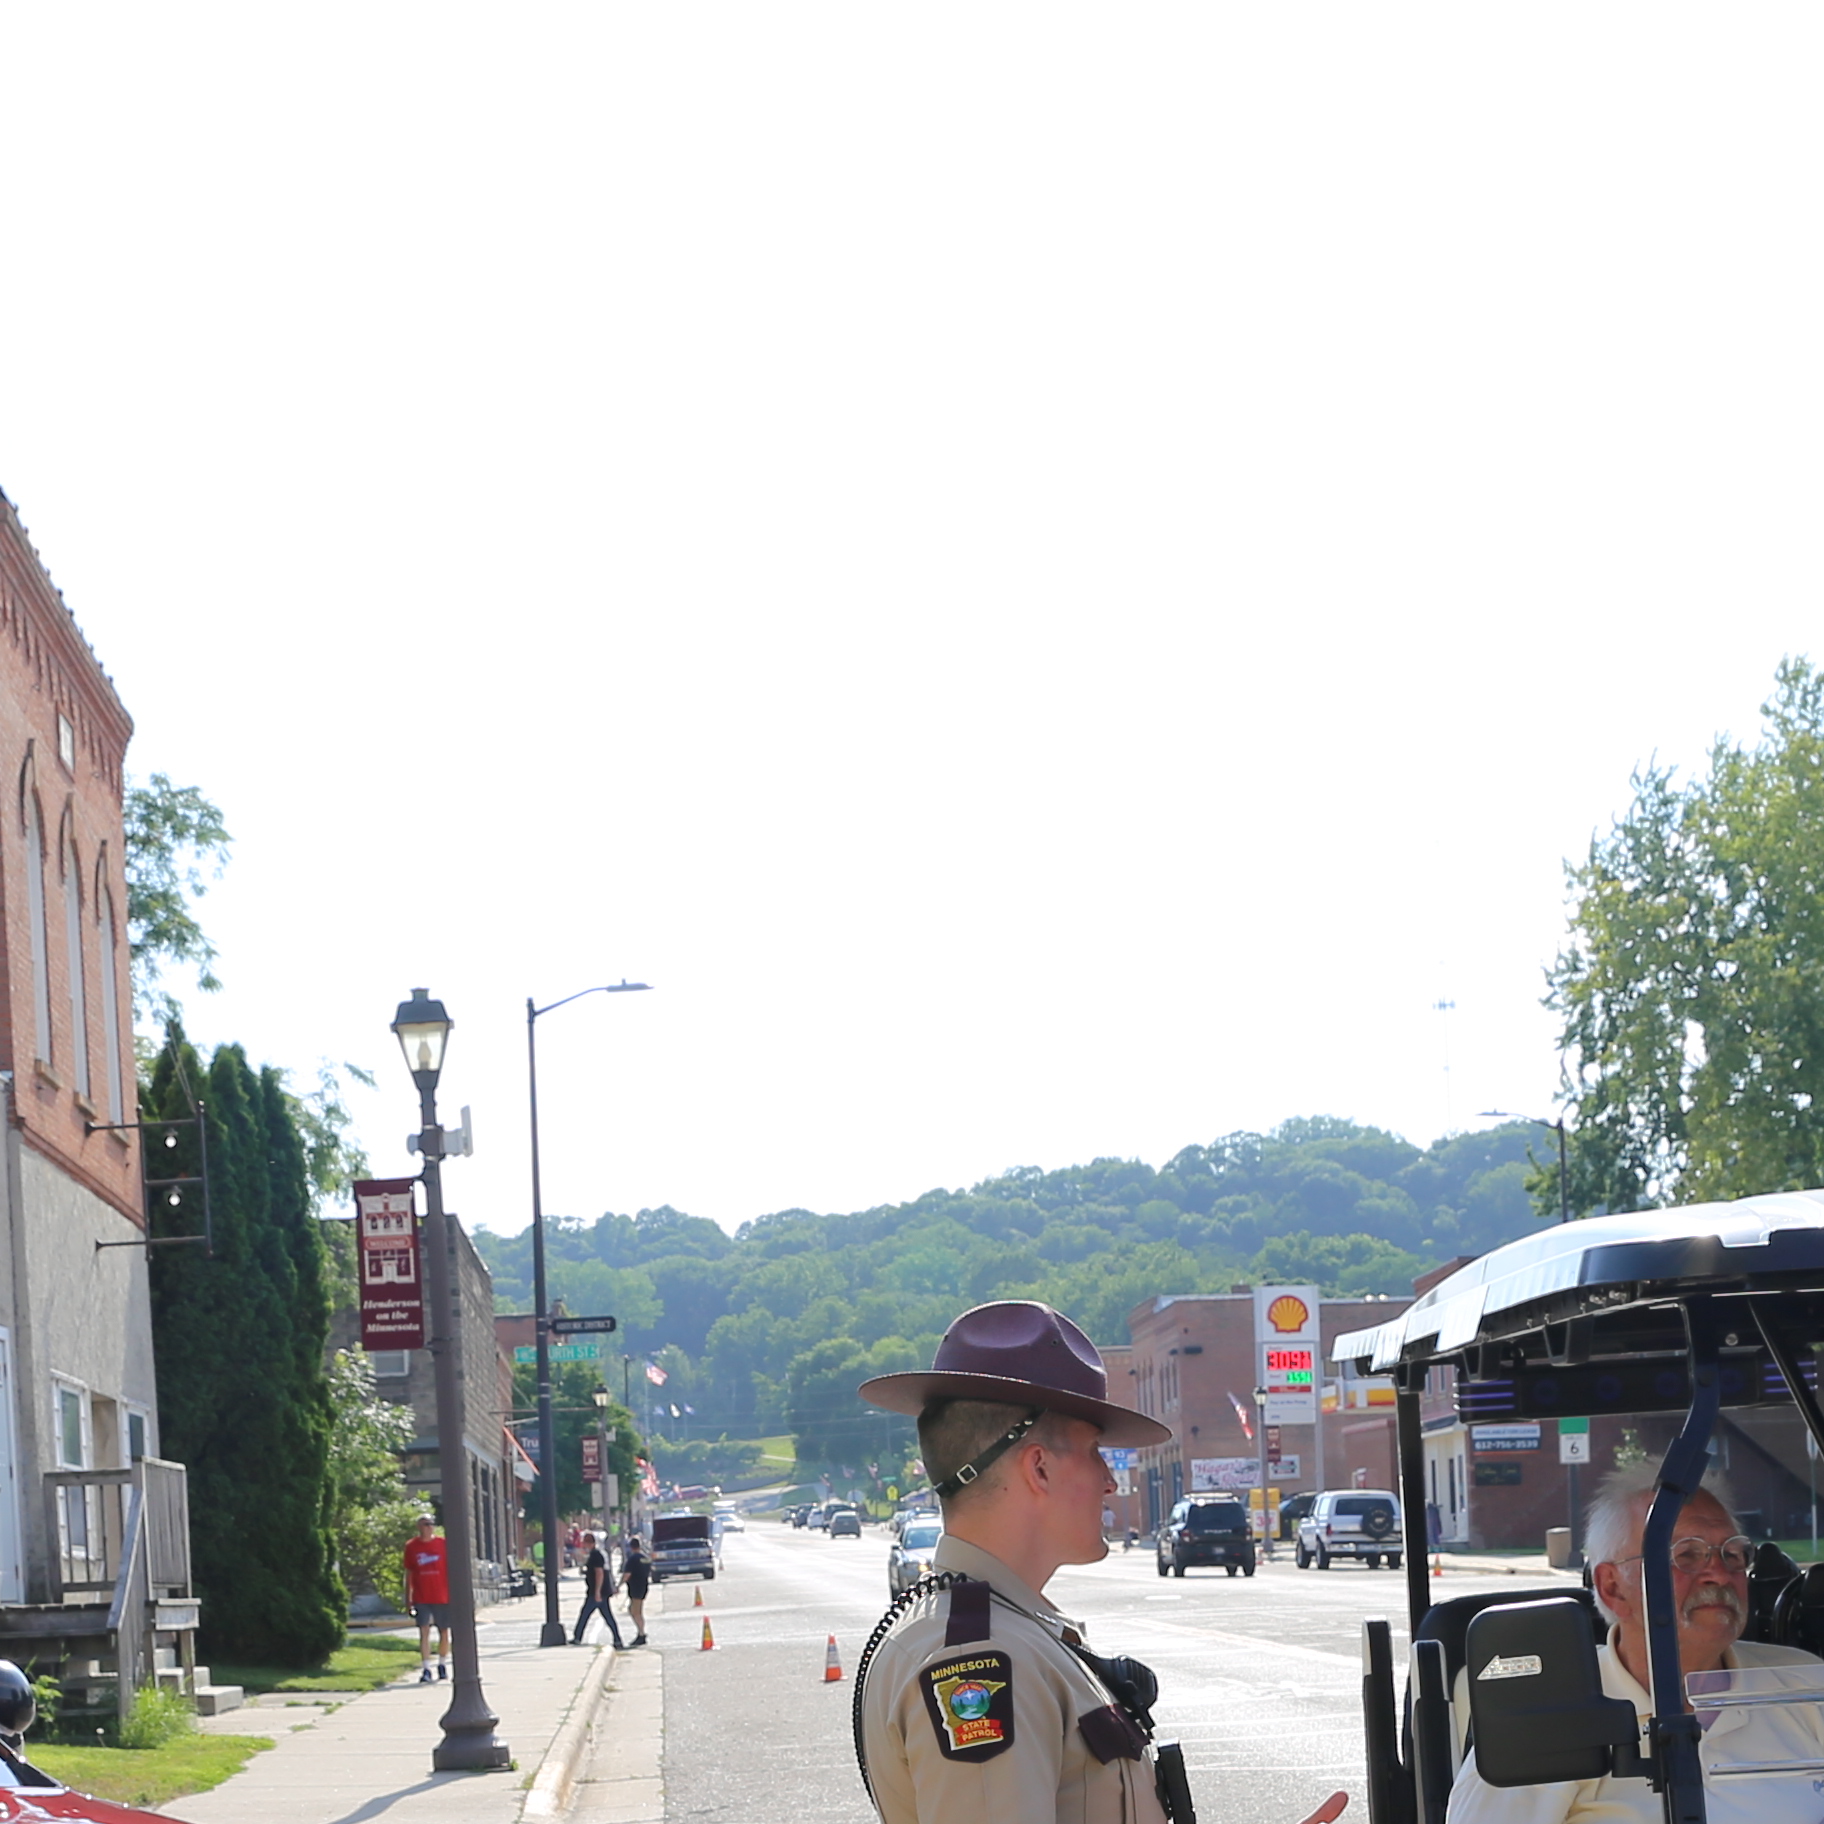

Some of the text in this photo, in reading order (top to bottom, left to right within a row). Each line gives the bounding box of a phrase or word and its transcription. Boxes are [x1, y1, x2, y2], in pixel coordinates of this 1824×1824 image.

[363, 1300, 420, 1309] Henderson
[391, 1311, 409, 1320] the
[366, 1322, 420, 1333] Minnesota
[1570, 1441, 1579, 1454] 6
[931, 1658, 1000, 1681] MINNESOTA
[962, 1719, 991, 1731] STATE
[962, 1729, 997, 1741] PATROL
